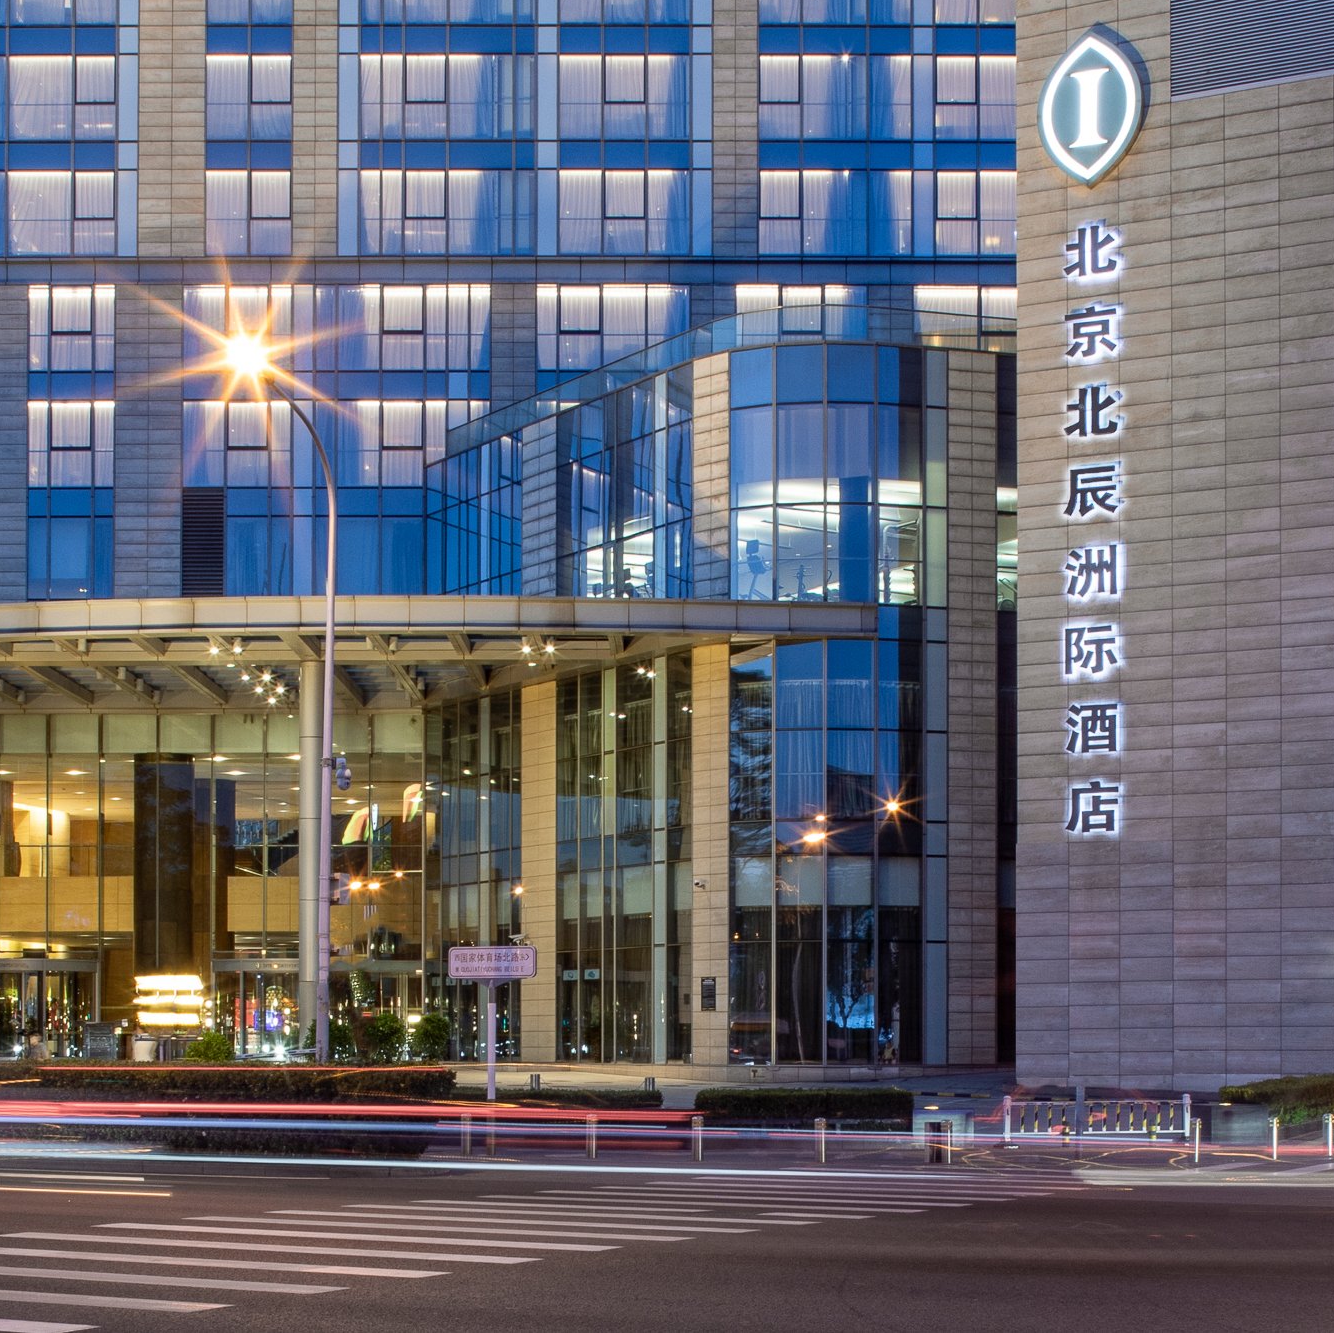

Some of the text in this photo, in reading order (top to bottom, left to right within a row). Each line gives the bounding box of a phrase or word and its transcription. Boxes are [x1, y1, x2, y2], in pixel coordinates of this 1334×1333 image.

[1063, 225, 1119, 833] 北京北辰洲际酒店
